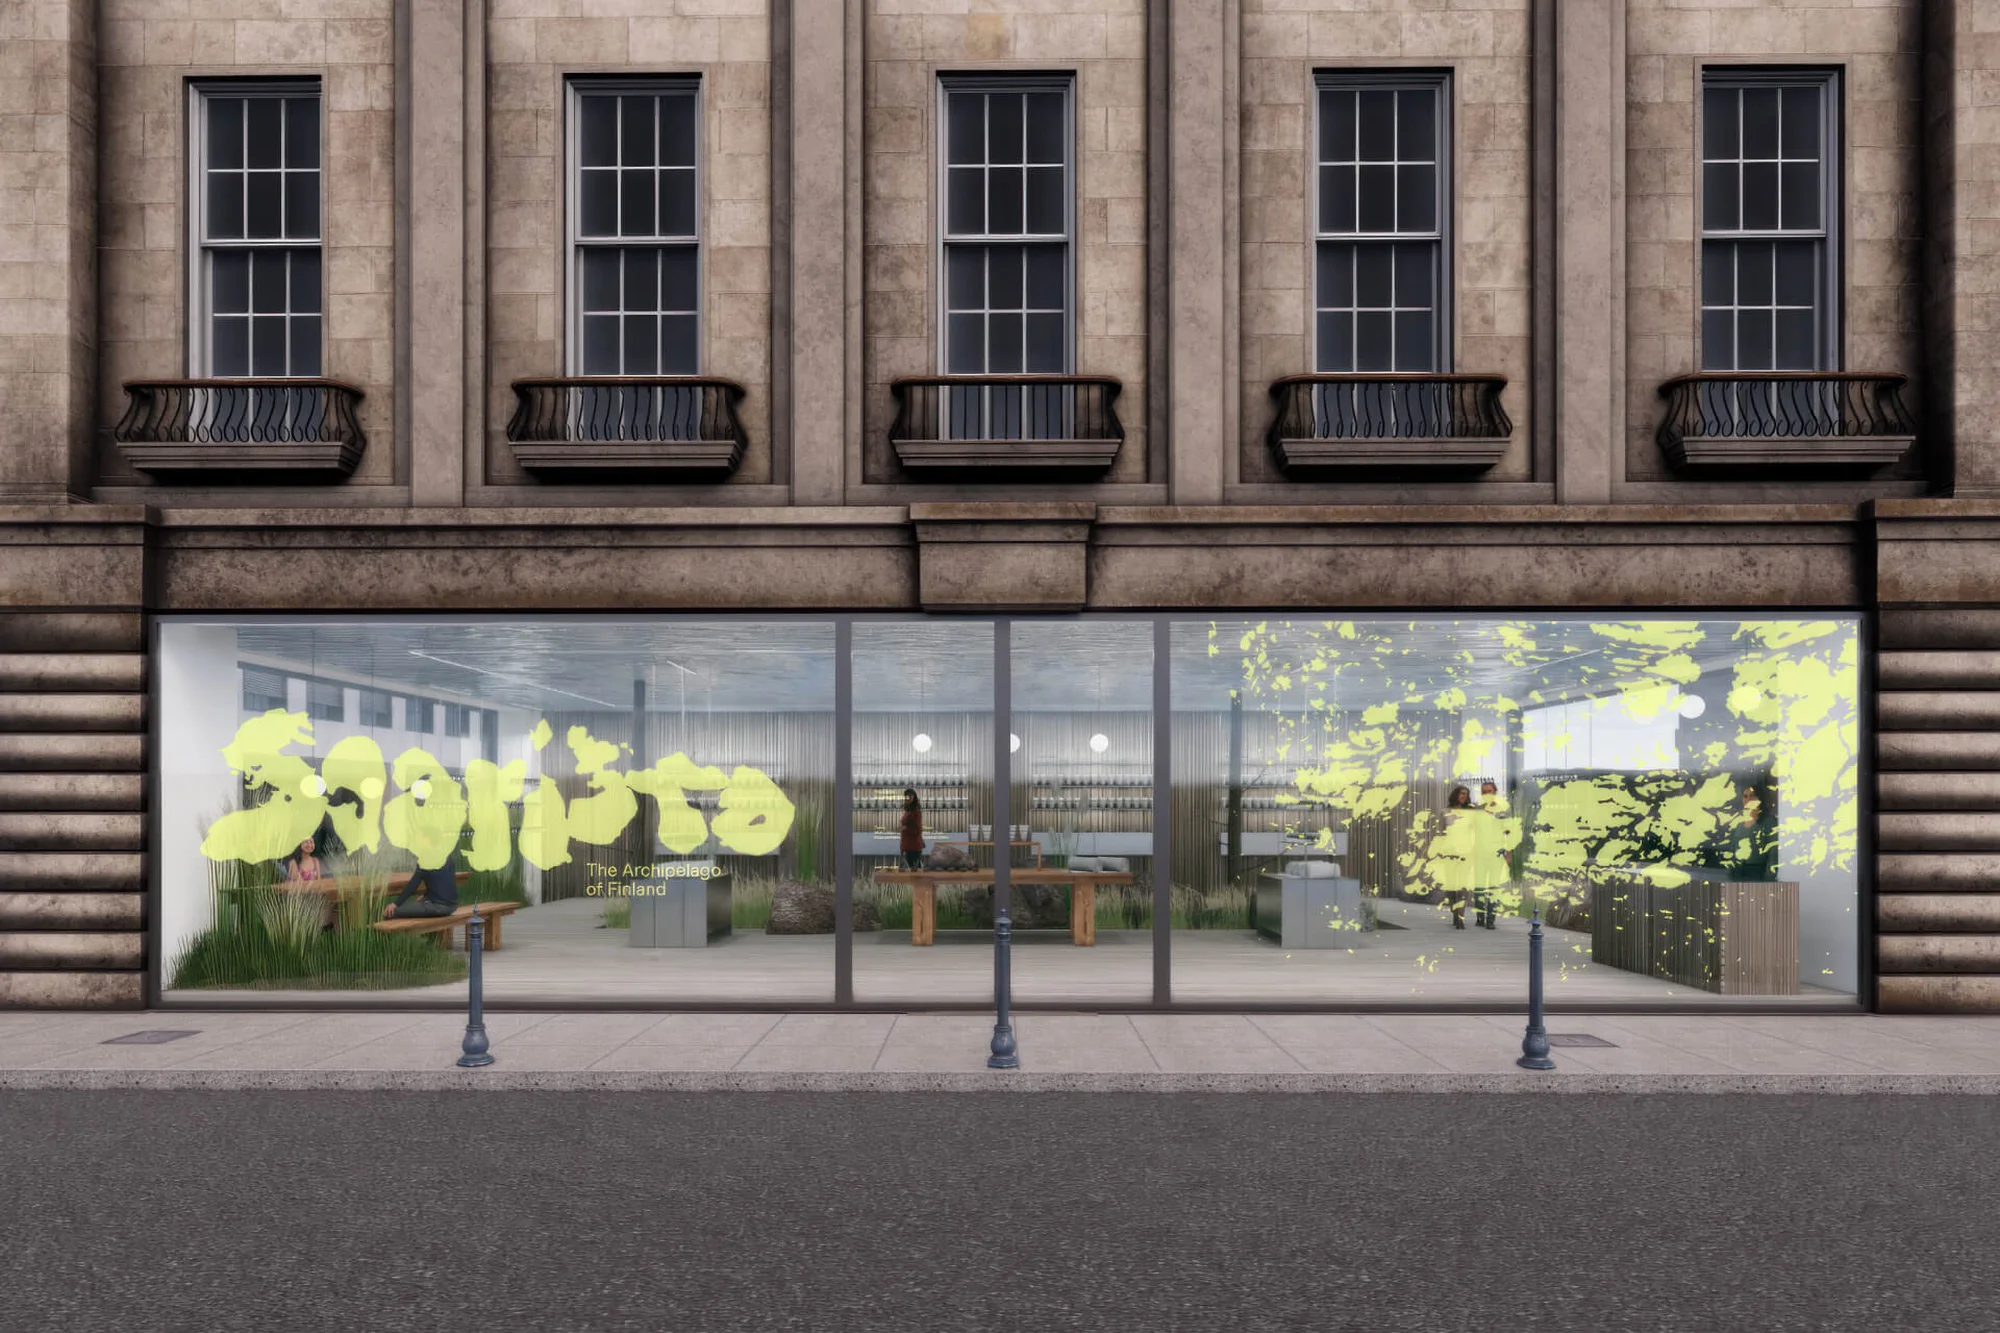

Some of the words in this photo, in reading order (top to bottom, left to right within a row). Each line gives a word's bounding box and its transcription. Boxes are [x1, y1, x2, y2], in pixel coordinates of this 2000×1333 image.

[586, 863, 618, 877] The
[622, 863, 722, 881] Archipelago
[586, 882, 603, 897] of
[608, 882, 666, 896] Finland
